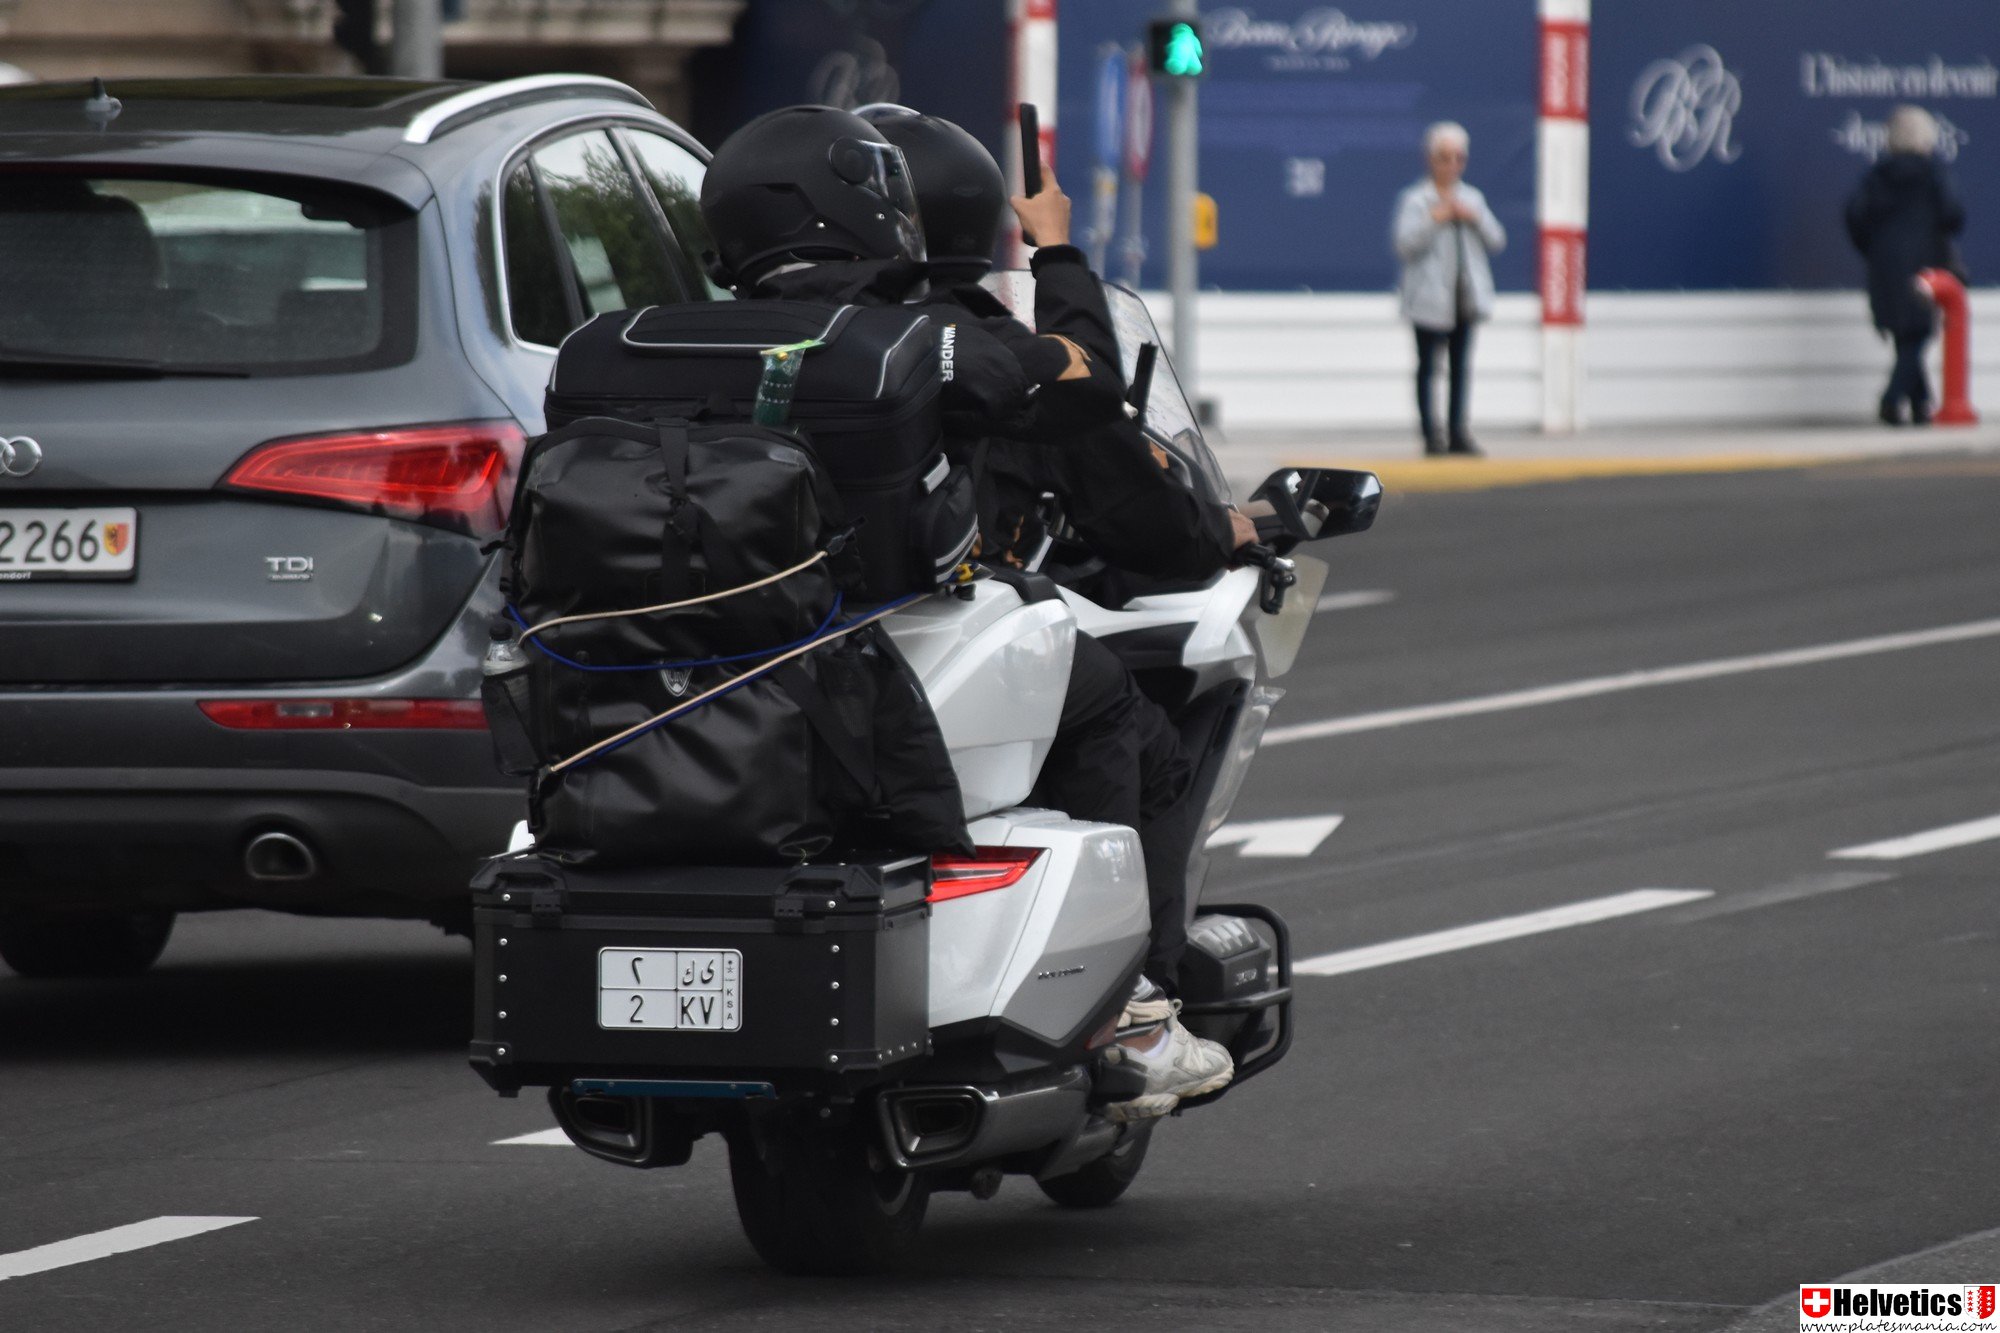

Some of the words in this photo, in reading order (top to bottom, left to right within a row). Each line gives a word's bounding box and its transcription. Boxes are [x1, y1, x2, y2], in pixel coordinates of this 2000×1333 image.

[266, 557, 314, 571] TDI
[629, 994, 644, 1023] 2
[680, 996, 715, 1025] KV
